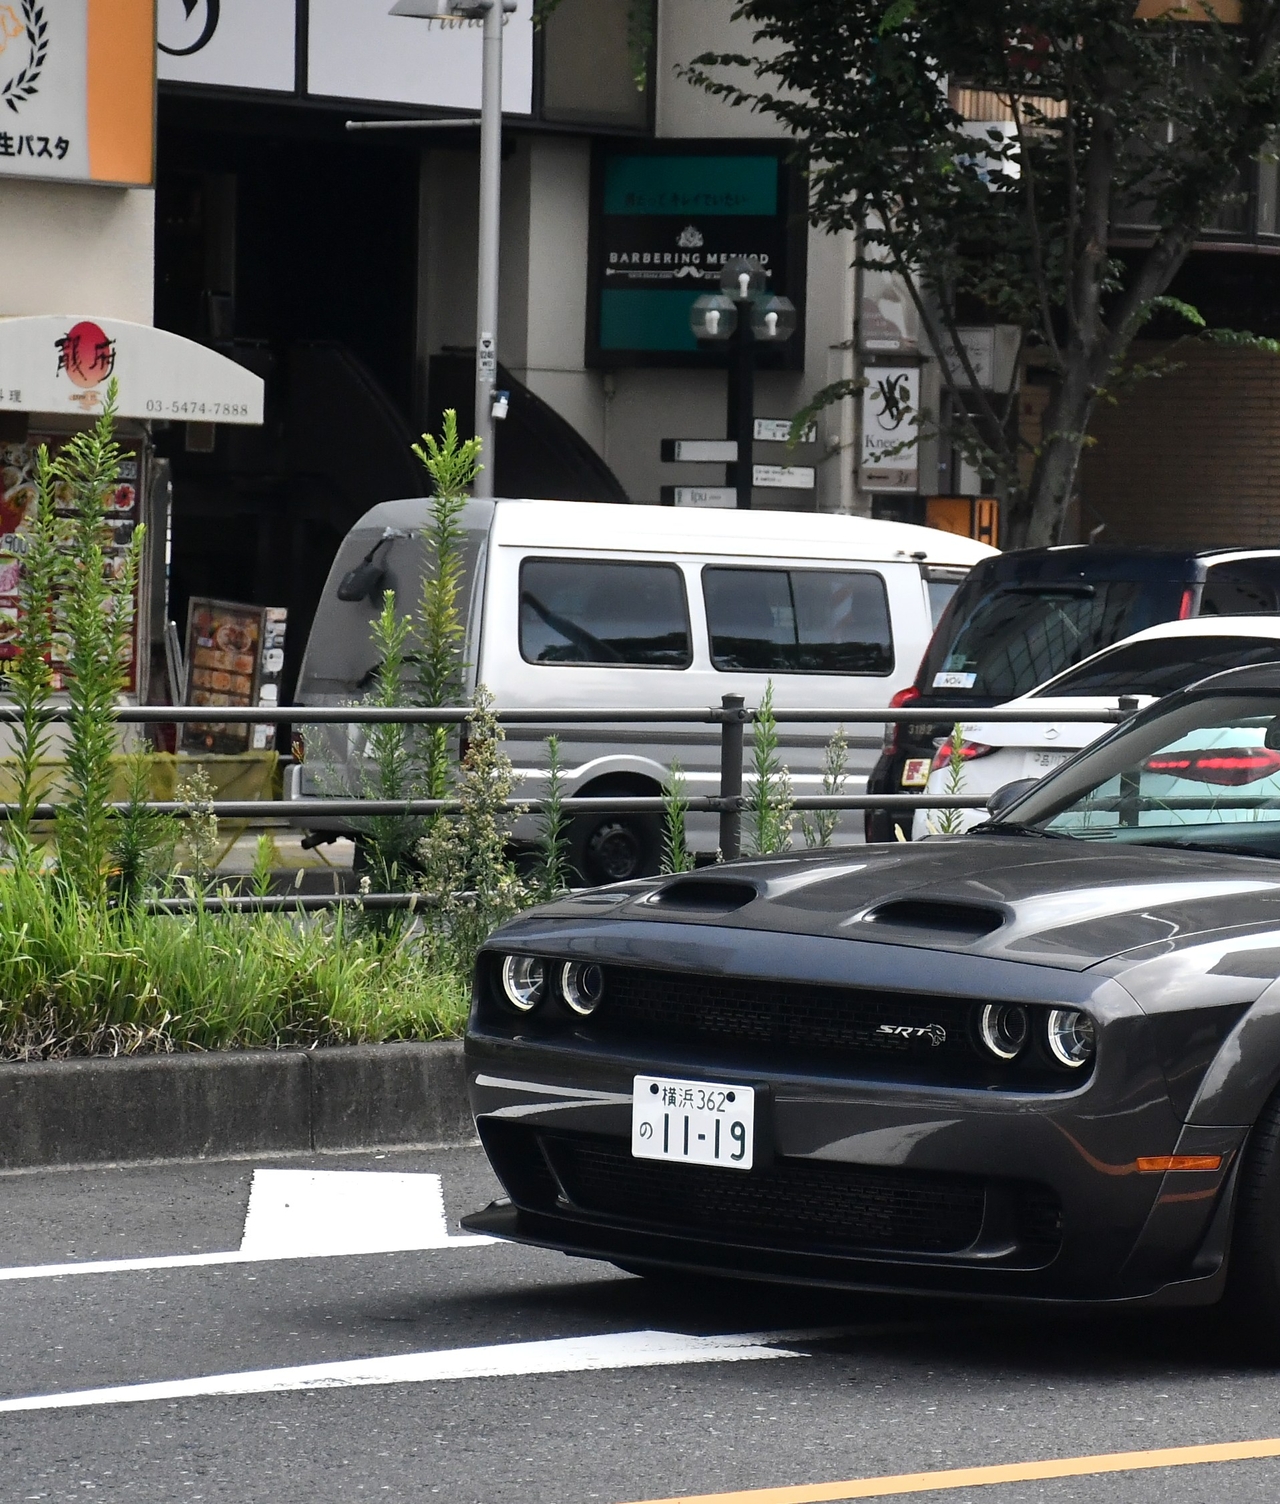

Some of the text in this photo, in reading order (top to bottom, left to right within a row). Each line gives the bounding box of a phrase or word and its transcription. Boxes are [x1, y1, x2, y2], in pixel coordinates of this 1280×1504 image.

[0, 132, 70, 160] 生パスタ
[609, 252, 700, 264] BARBERING
[146, 399, 249, 416] 03-5474-7888
[876, 1024, 932, 1039] SRT
[639, 1112, 746, 1162] の 11-19
